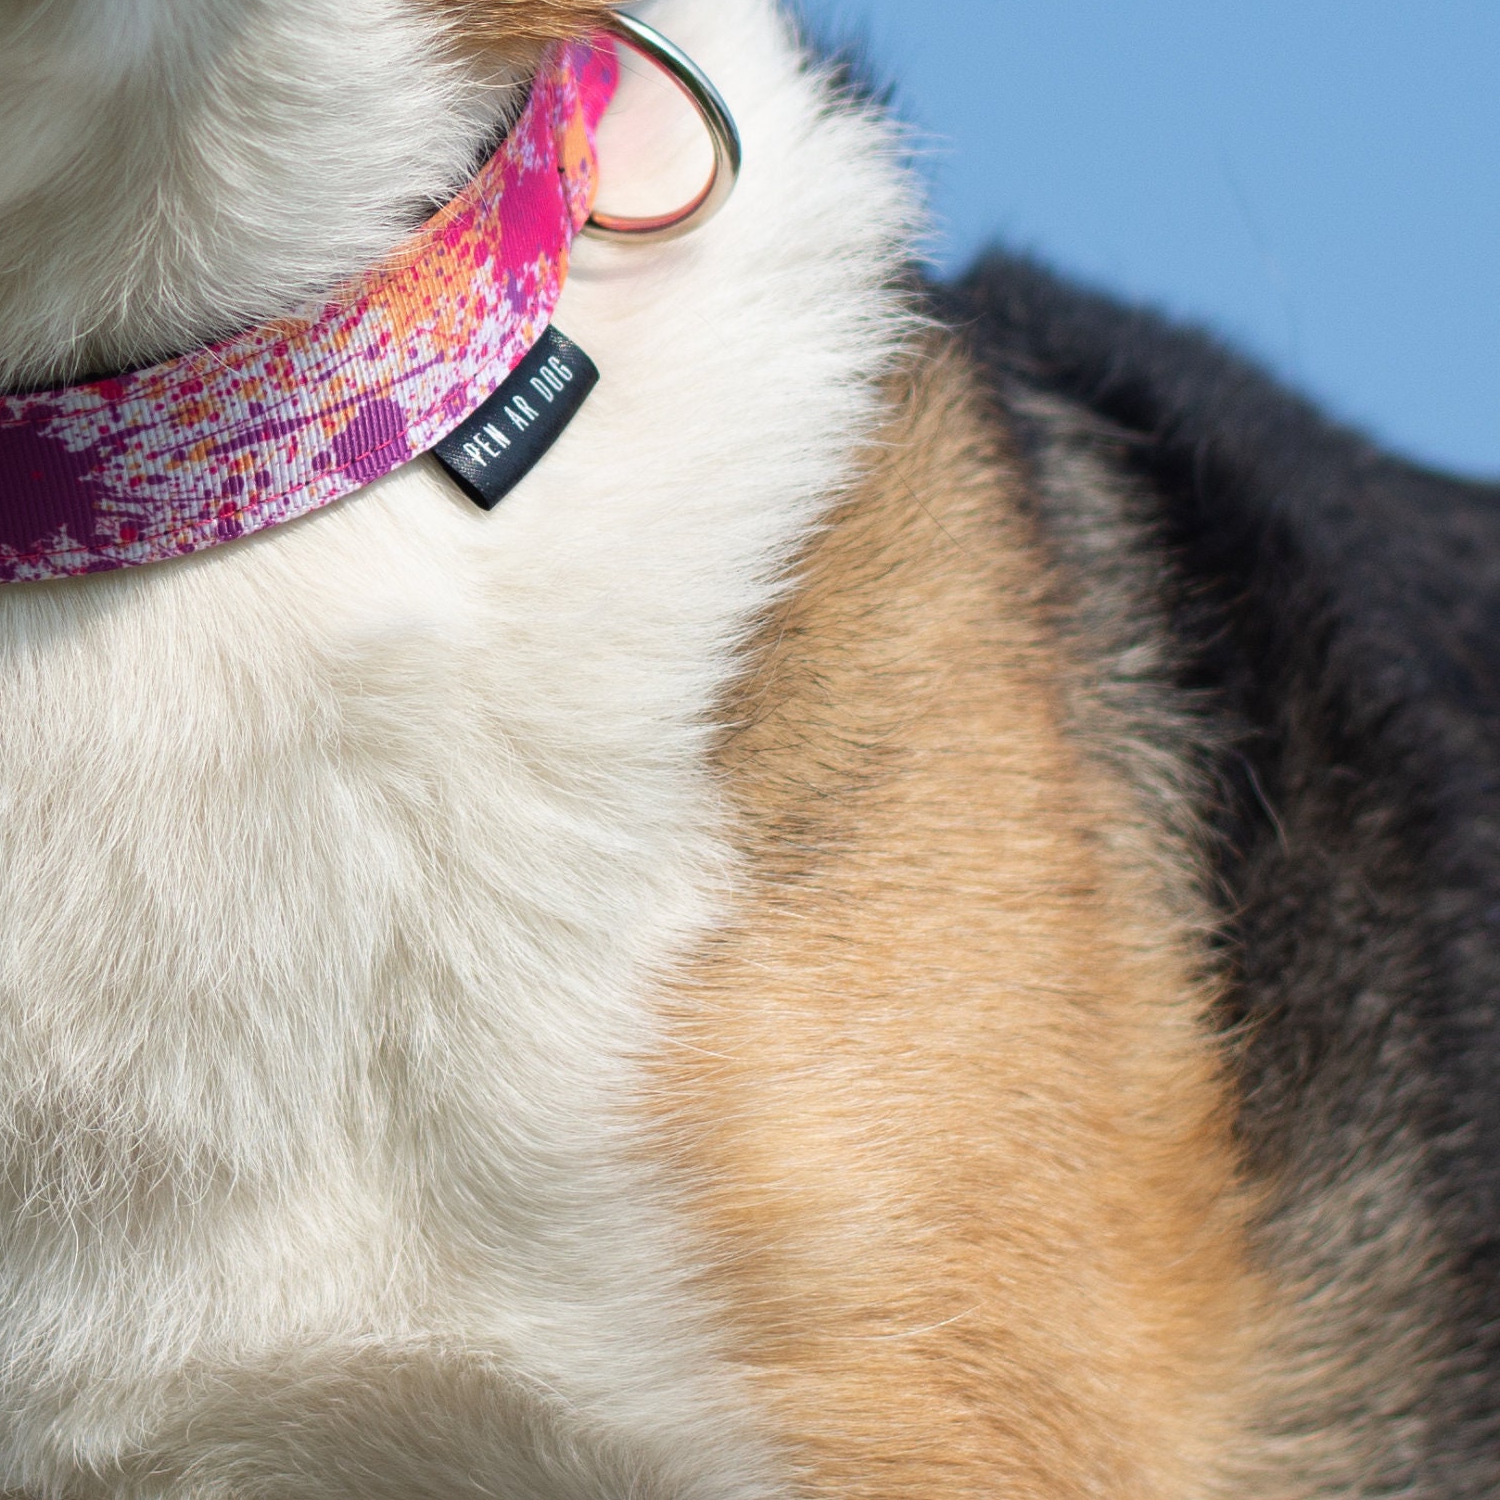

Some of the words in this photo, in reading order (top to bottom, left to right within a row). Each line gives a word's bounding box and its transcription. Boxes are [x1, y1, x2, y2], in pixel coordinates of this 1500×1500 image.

[462, 423, 511, 467] PEN
[503, 395, 540, 431] AR
[529, 355, 573, 403] DOG
